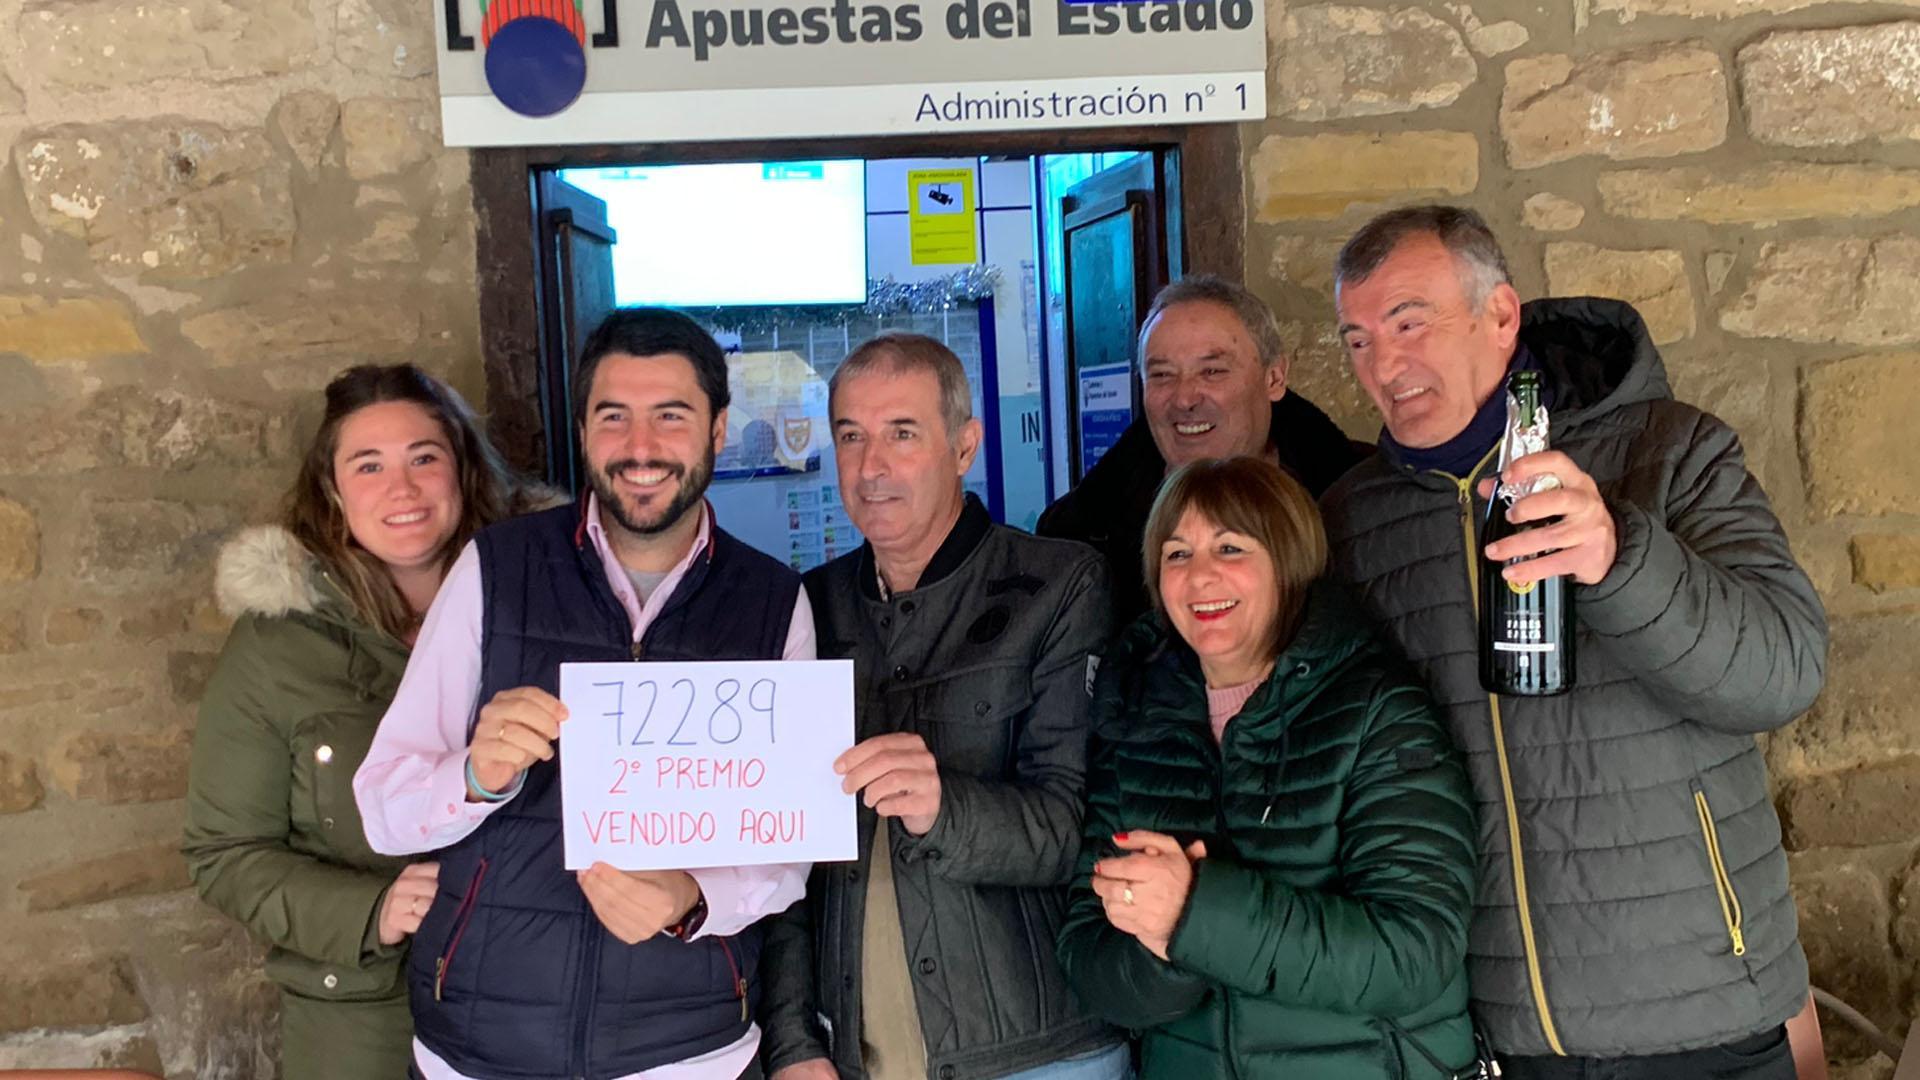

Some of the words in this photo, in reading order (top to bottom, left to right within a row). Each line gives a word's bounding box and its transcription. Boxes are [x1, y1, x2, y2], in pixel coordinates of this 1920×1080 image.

[645, 0, 924, 61] Apuestas
[945, 0, 1032, 40] del
[1057, 0, 1254, 36] Estado
[915, 86, 1168, 122] Administración
[1234, 83, 1248, 111] 1
[591, 678, 777, 746] 72289
[656, 756, 766, 791] PREMIO
[582, 810, 717, 846] VENDIDO
[738, 808, 804, 845] AQUI
